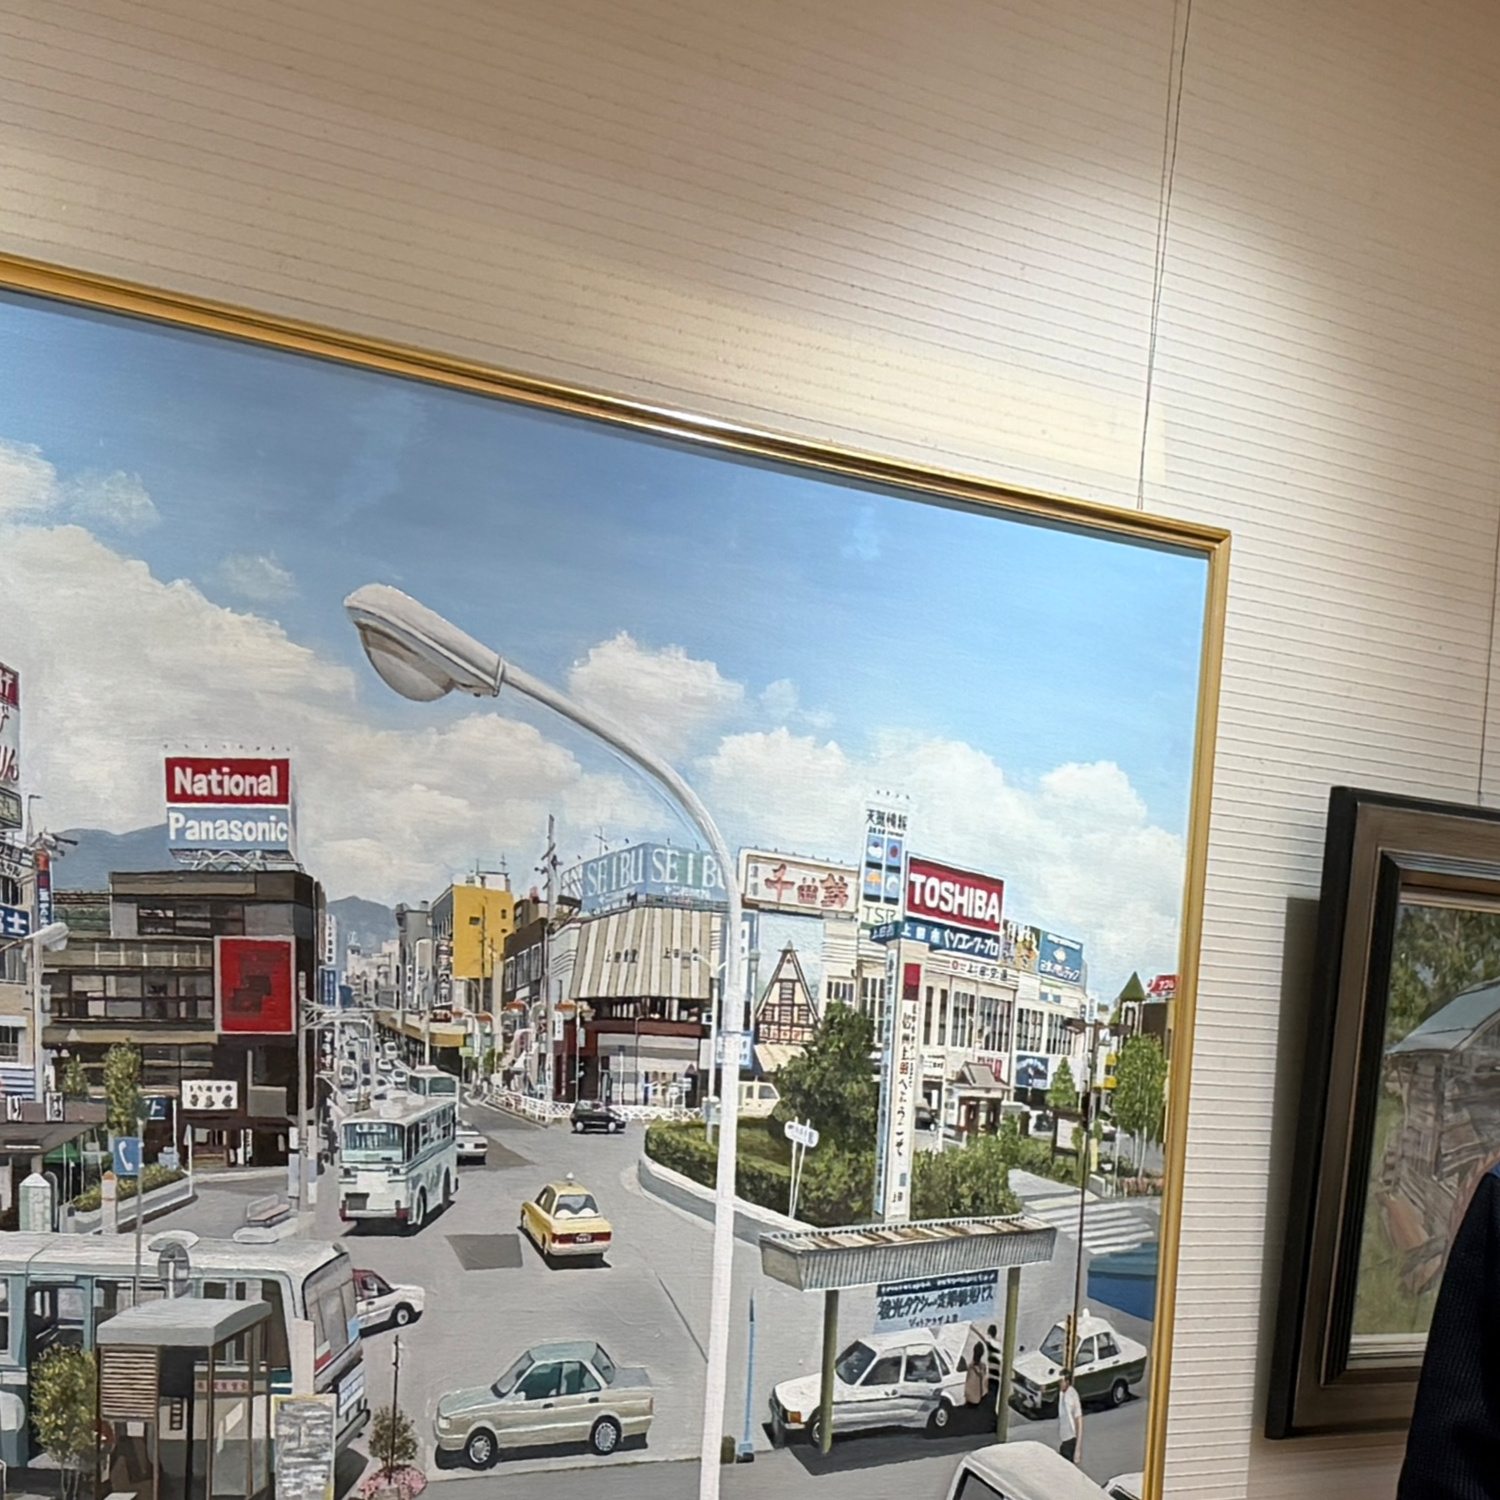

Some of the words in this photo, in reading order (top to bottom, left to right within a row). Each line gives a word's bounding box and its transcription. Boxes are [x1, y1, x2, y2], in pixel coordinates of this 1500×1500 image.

[174, 765, 278, 797] National
[168, 811, 288, 842] Panasonic
[586, 847, 645, 897] SEIBU
[909, 872, 1000, 924] TOSHIBA
